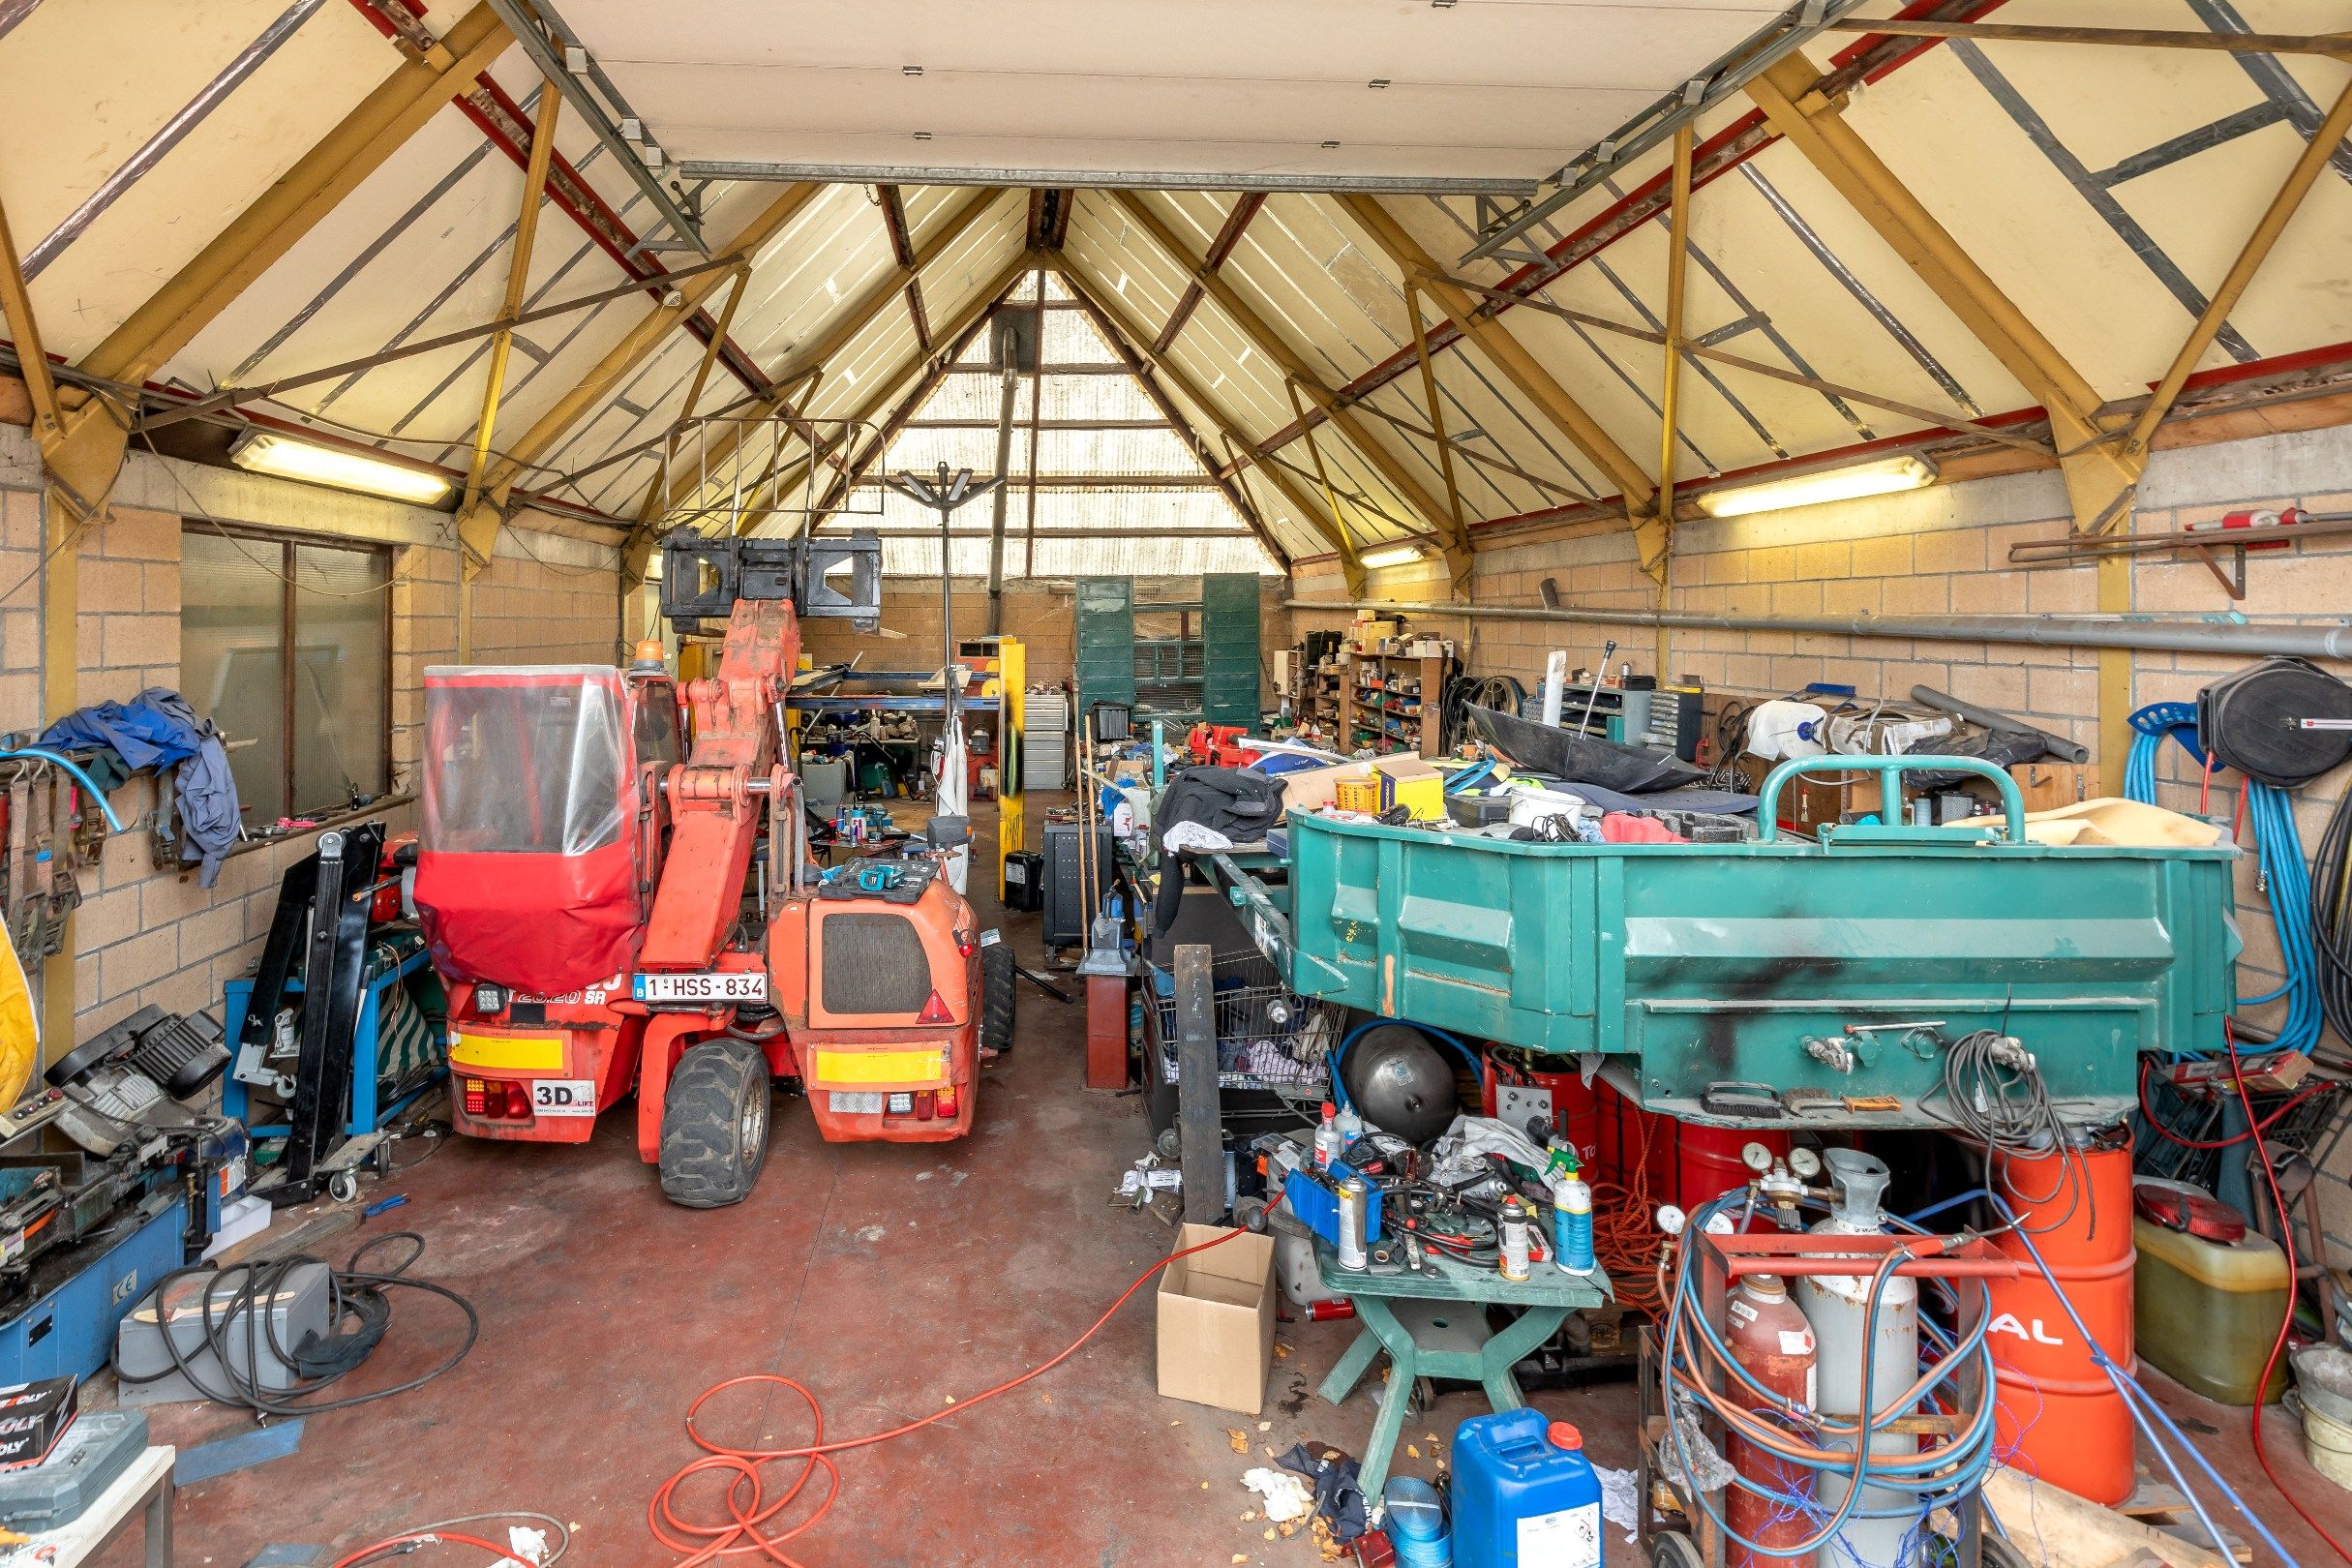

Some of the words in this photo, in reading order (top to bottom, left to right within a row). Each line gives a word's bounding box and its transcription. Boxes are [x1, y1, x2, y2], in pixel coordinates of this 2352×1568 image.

[584, 990, 607, 1005] SR
[636, 988, 645, 998] B
[536, 1086, 573, 1105] 3D
[117, 1274, 133, 1299] CE
